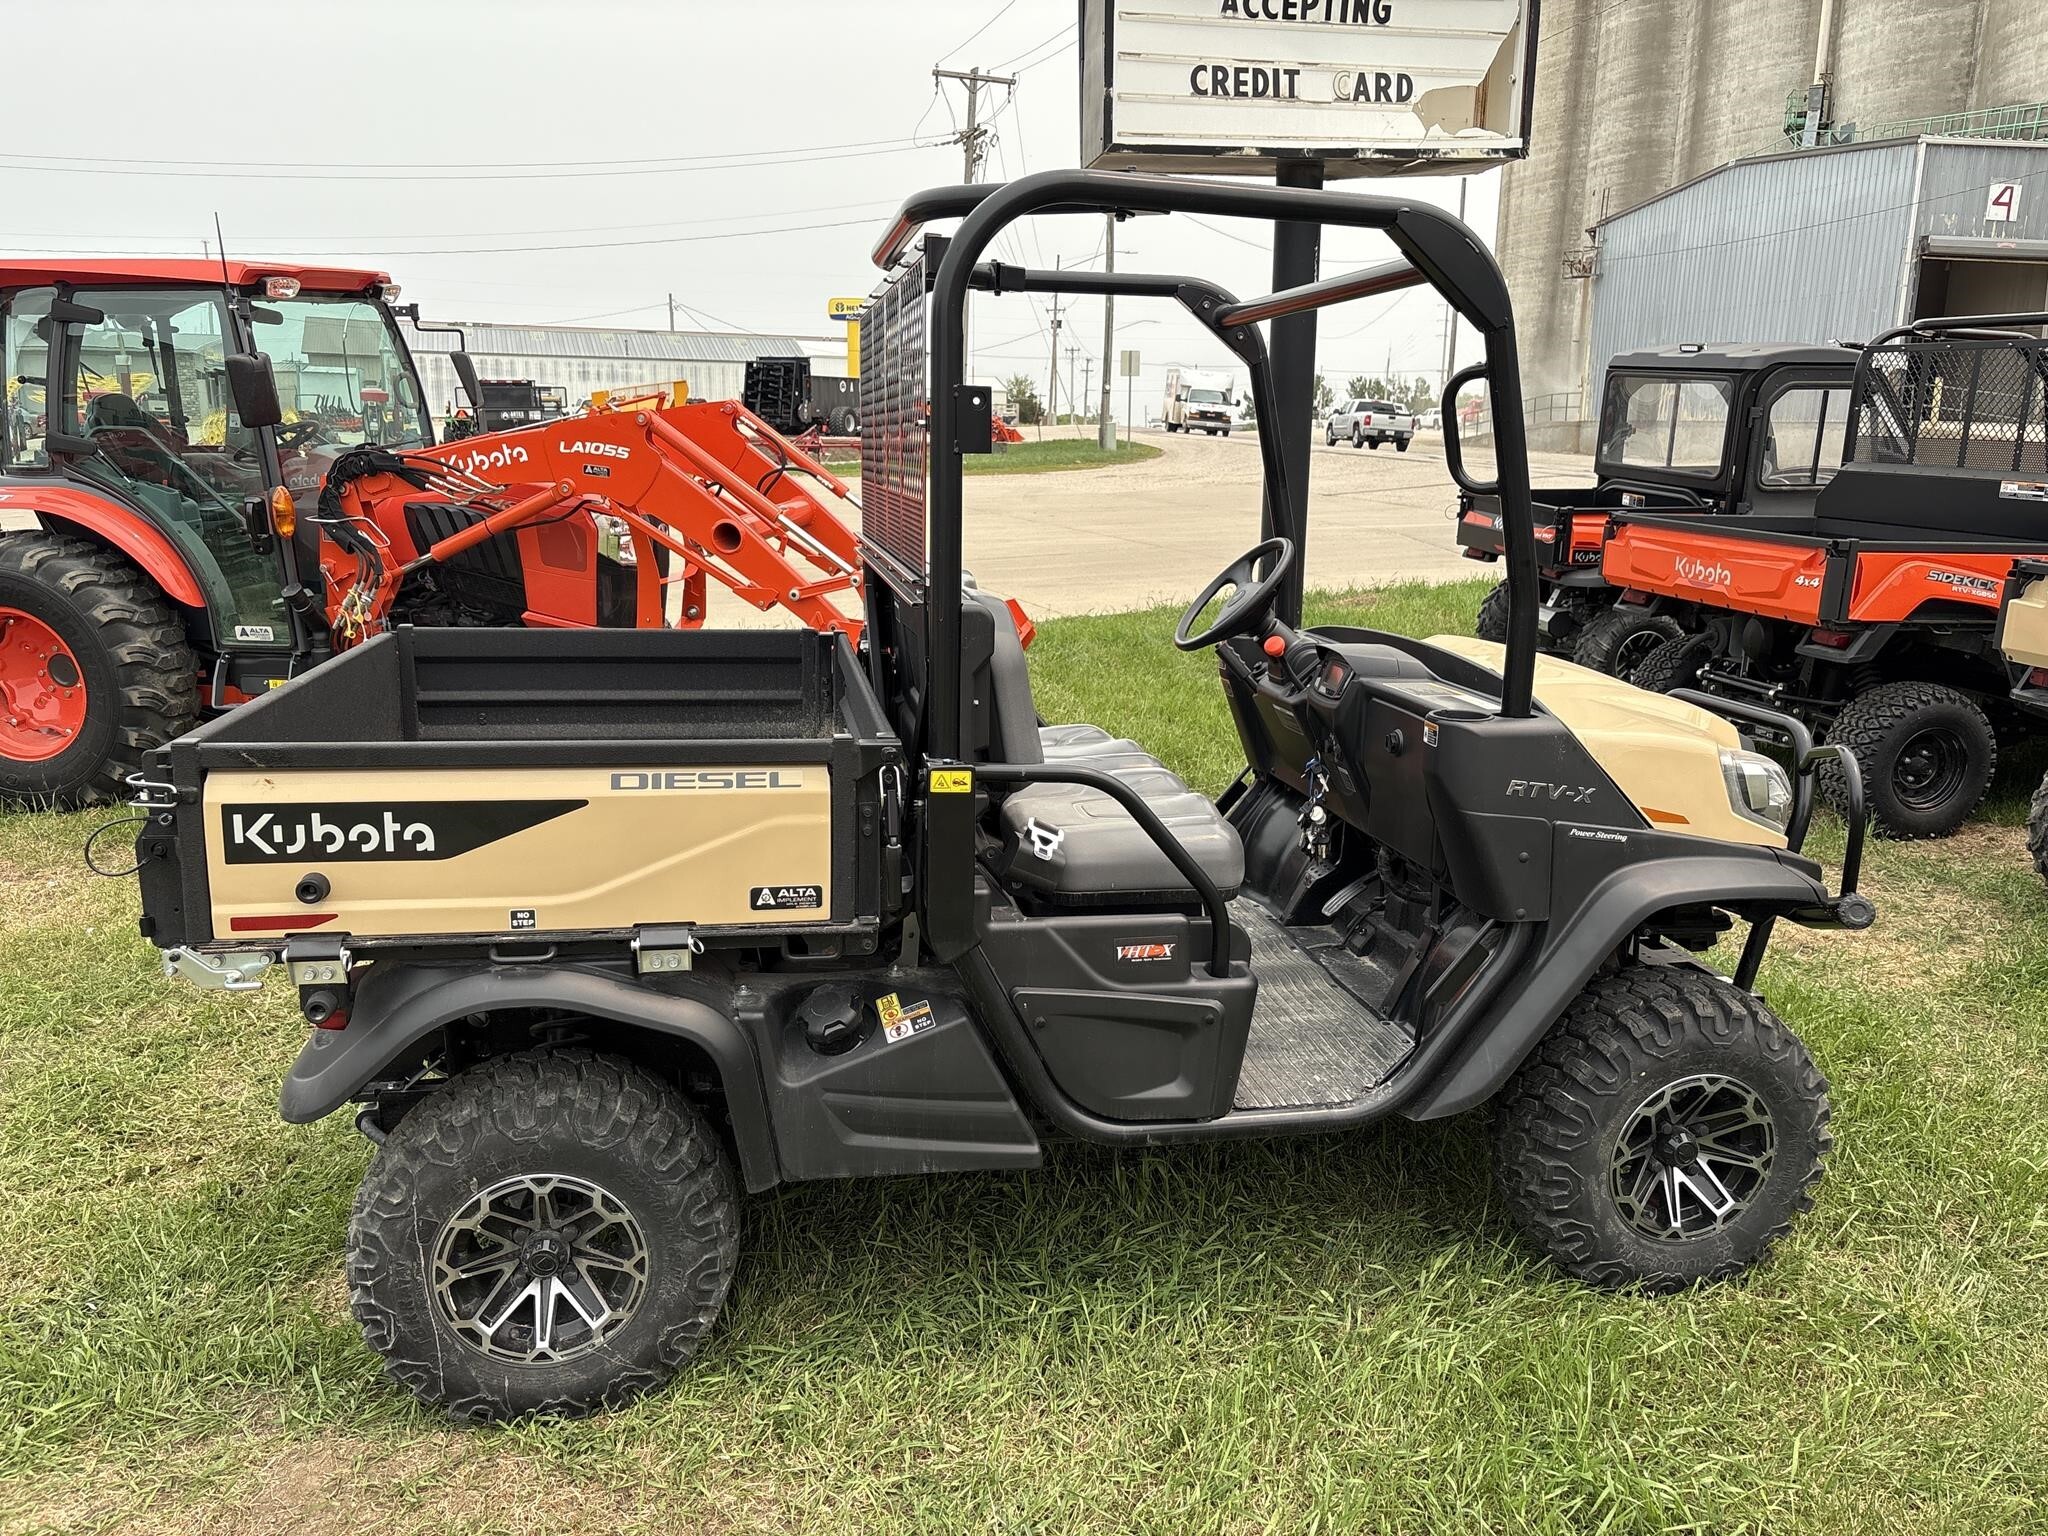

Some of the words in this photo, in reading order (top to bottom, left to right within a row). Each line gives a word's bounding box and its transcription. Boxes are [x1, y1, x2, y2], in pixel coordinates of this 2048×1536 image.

[1220, 0, 1393, 25] ACCEPTING
[1190, 64, 1301, 99] CREDIT
[1332, 70, 1414, 103] CARD
[1991, 185, 2015, 223] 4
[440, 443, 529, 475] Kubota
[559, 441, 631, 460] LA1055
[1675, 556, 1732, 587] Kubota
[1794, 575, 1820, 588] 4x4
[1927, 570, 1999, 592] SIDEKICK
[610, 771, 802, 790] DIESEL
[1505, 780, 1597, 804] RTV-X
[232, 811, 436, 855] Kubota
[1570, 828, 1595, 838] Power
[1595, 831, 1628, 843] Steering
[777, 887, 817, 897] ALTA
[512, 919, 534, 927] STEP
[1116, 943, 1176, 961] VHT-X
[914, 1020, 931, 1030] STEP
[916, 1016, 927, 1024] NO
